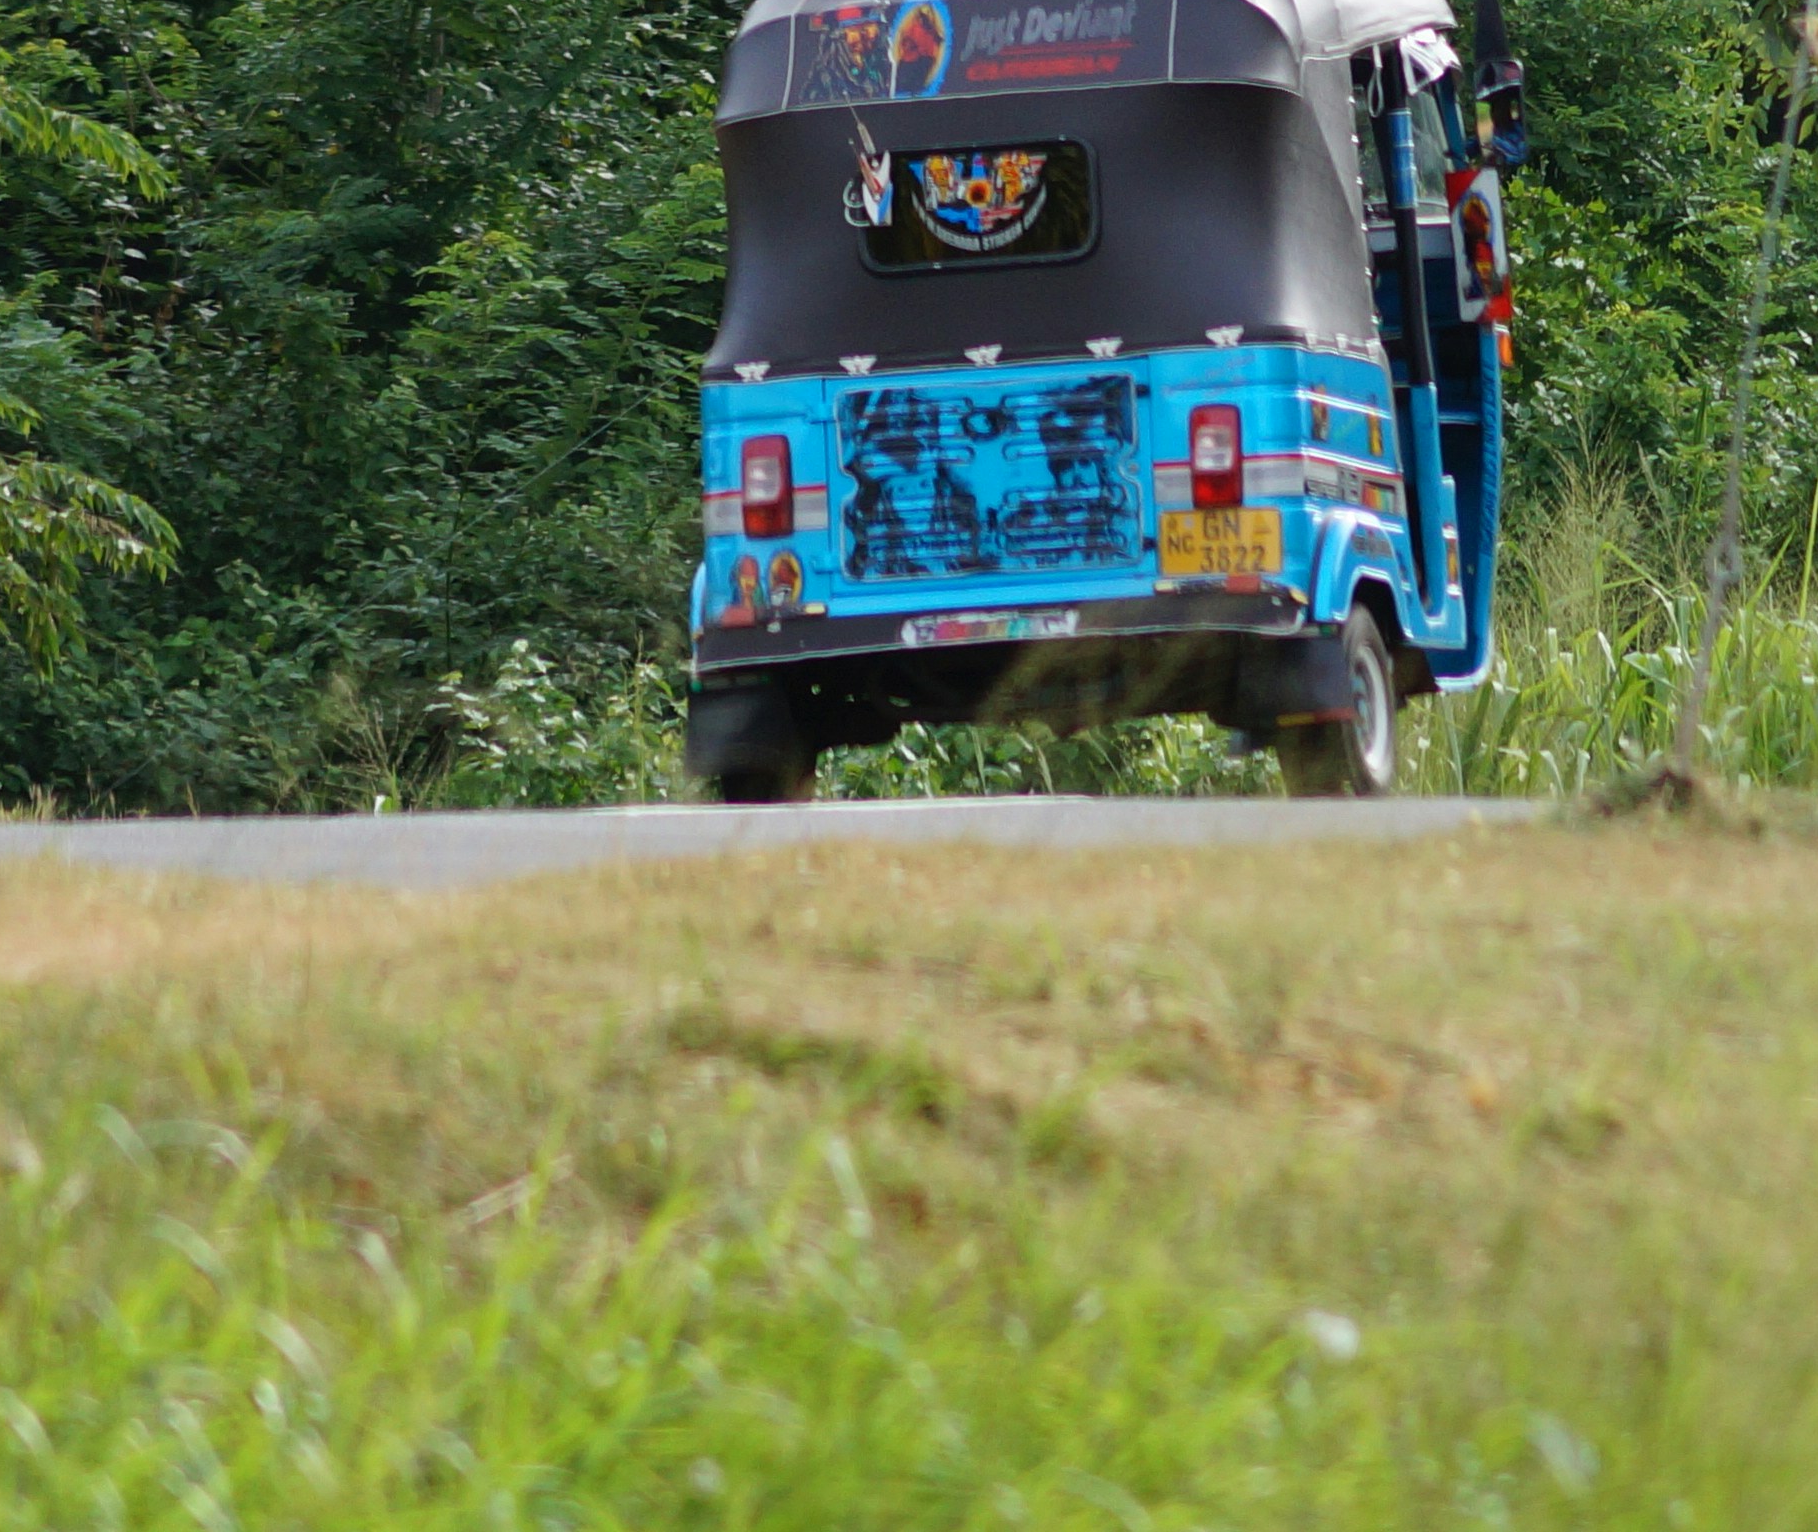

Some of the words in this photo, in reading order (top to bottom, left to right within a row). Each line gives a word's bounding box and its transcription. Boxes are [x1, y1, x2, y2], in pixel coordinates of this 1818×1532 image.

[1204, 509, 1241, 541] GN
[1167, 534, 1195, 556] NC
[1200, 545, 1266, 573] 3822
